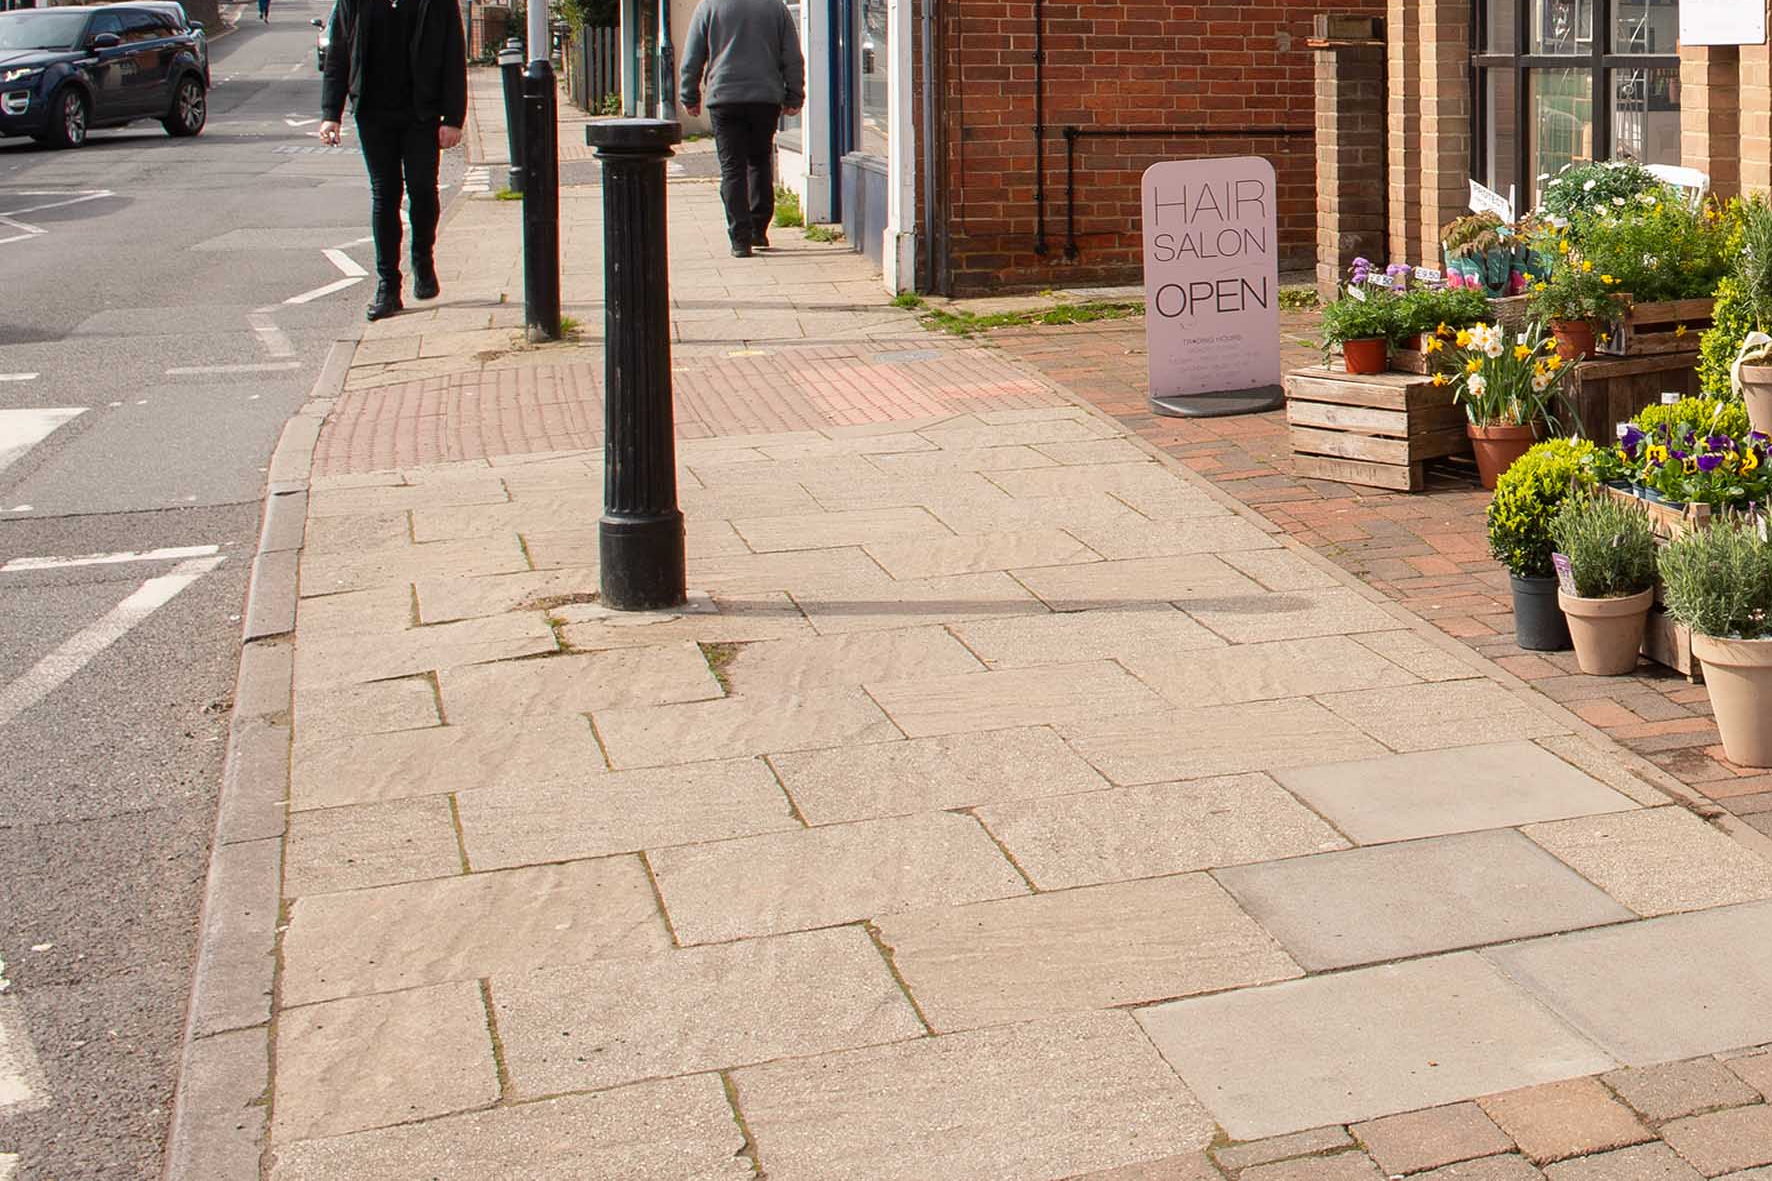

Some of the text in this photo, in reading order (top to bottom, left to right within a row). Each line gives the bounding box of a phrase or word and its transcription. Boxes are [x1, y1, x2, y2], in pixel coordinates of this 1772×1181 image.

[1154, 179, 1266, 226] HAIR
[1153, 227, 1266, 262] SALON
[1156, 276, 1268, 319] OPEN
